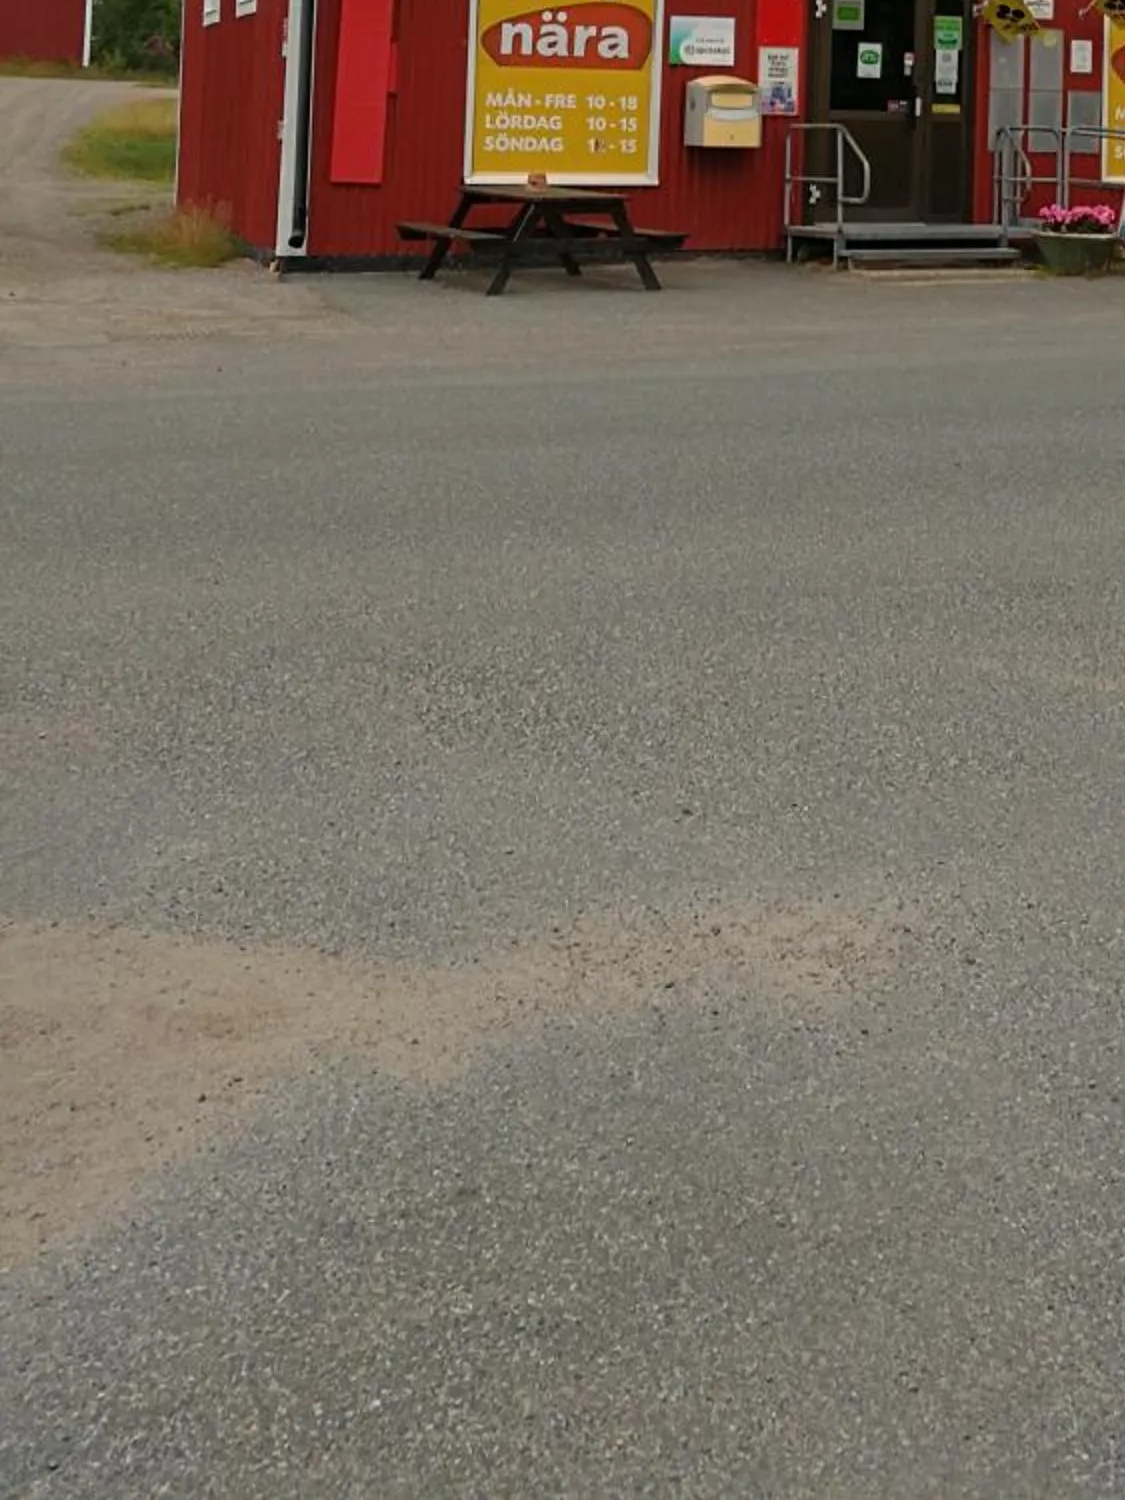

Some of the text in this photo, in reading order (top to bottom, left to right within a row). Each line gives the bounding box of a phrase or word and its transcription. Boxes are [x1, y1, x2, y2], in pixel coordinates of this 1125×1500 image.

[500, 11, 629, 59] nära
[485, 88, 531, 108] MÅN
[544, 93, 577, 109] FRE
[586, 95, 606, 110] 10
[485, 111, 562, 130] LÖRDAG
[586, 117, 606, 131] 10
[620, 117, 638, 132] 15
[484, 132, 564, 152] SÖNDAG
